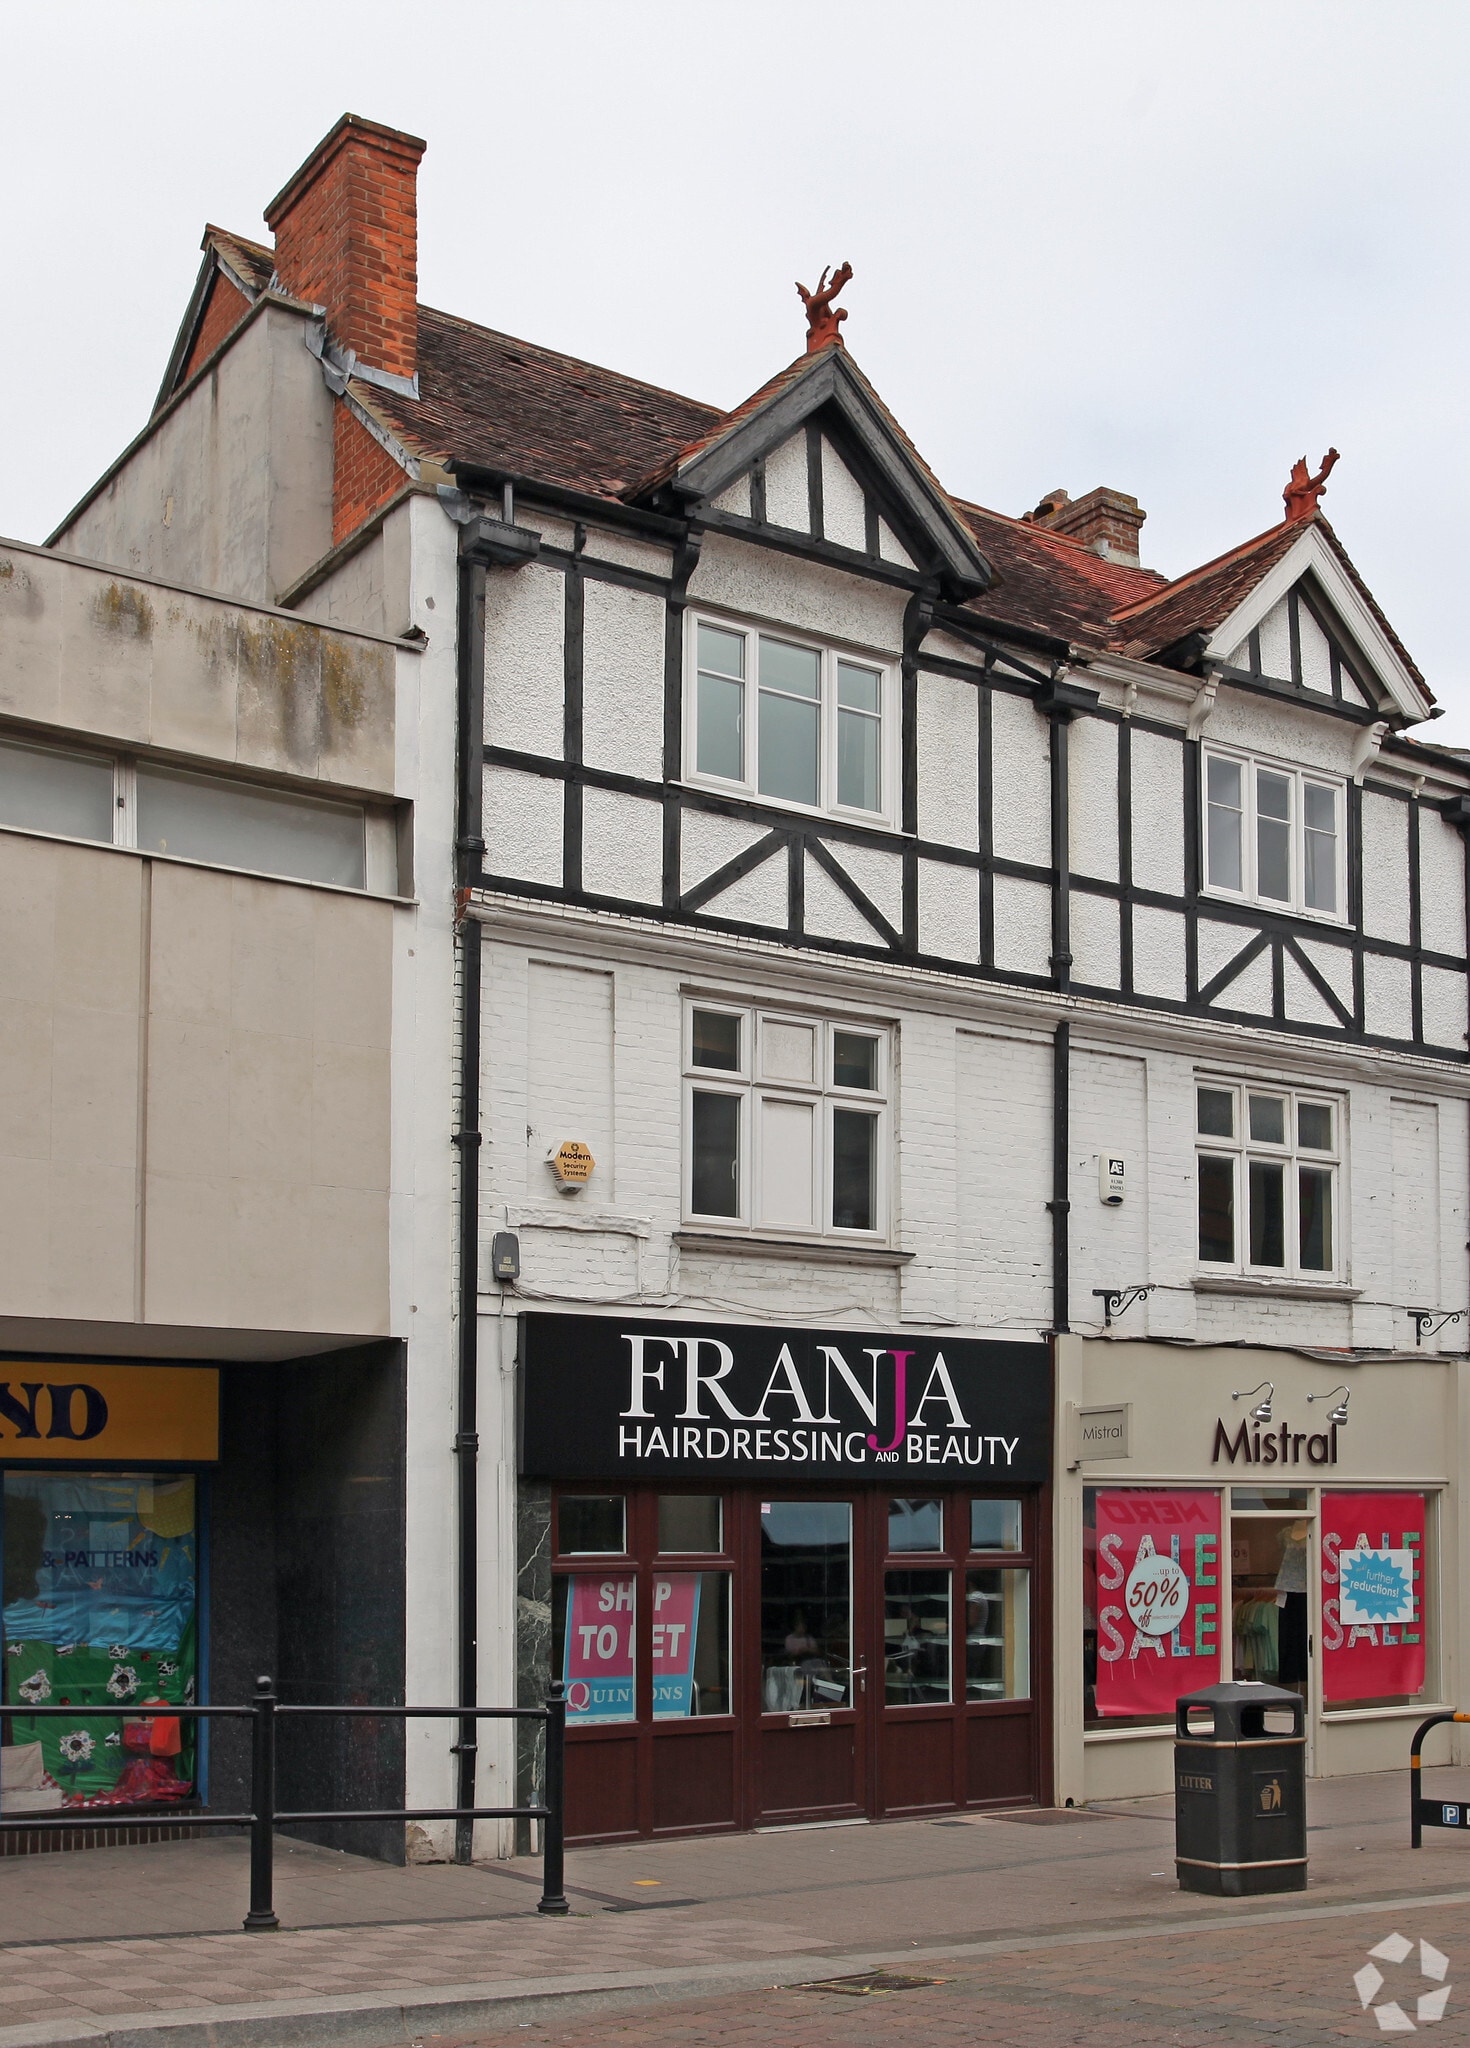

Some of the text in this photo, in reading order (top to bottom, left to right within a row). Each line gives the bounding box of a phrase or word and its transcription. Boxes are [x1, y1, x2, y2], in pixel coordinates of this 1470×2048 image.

[560, 1151, 591, 1160] Modern
[563, 1162, 587, 1171] Security
[563, 1169, 587, 1177] Systems
[619, 1334, 972, 1452] FRANJA
[1082, 1424, 1123, 1441] Mistral
[1212, 1417, 1338, 1465] Mistral
[619, 1425, 1020, 1466] HAIRDRESSING AND BEAUTY
[64, 1550, 159, 1568] PATTERNS
[1171, 1566, 1180, 1575] to
[1366, 1569, 1394, 1584] further
[598, 1582, 672, 1612] SHP
[1129, 1577, 1180, 1607] 50%
[1350, 1580, 1399, 1598] reductions!
[578, 1624, 618, 1660] TO
[566, 1682, 683, 1712] QUINNS
[1180, 1776, 1213, 1790] LITTER
[1446, 1806, 1457, 1822] P
